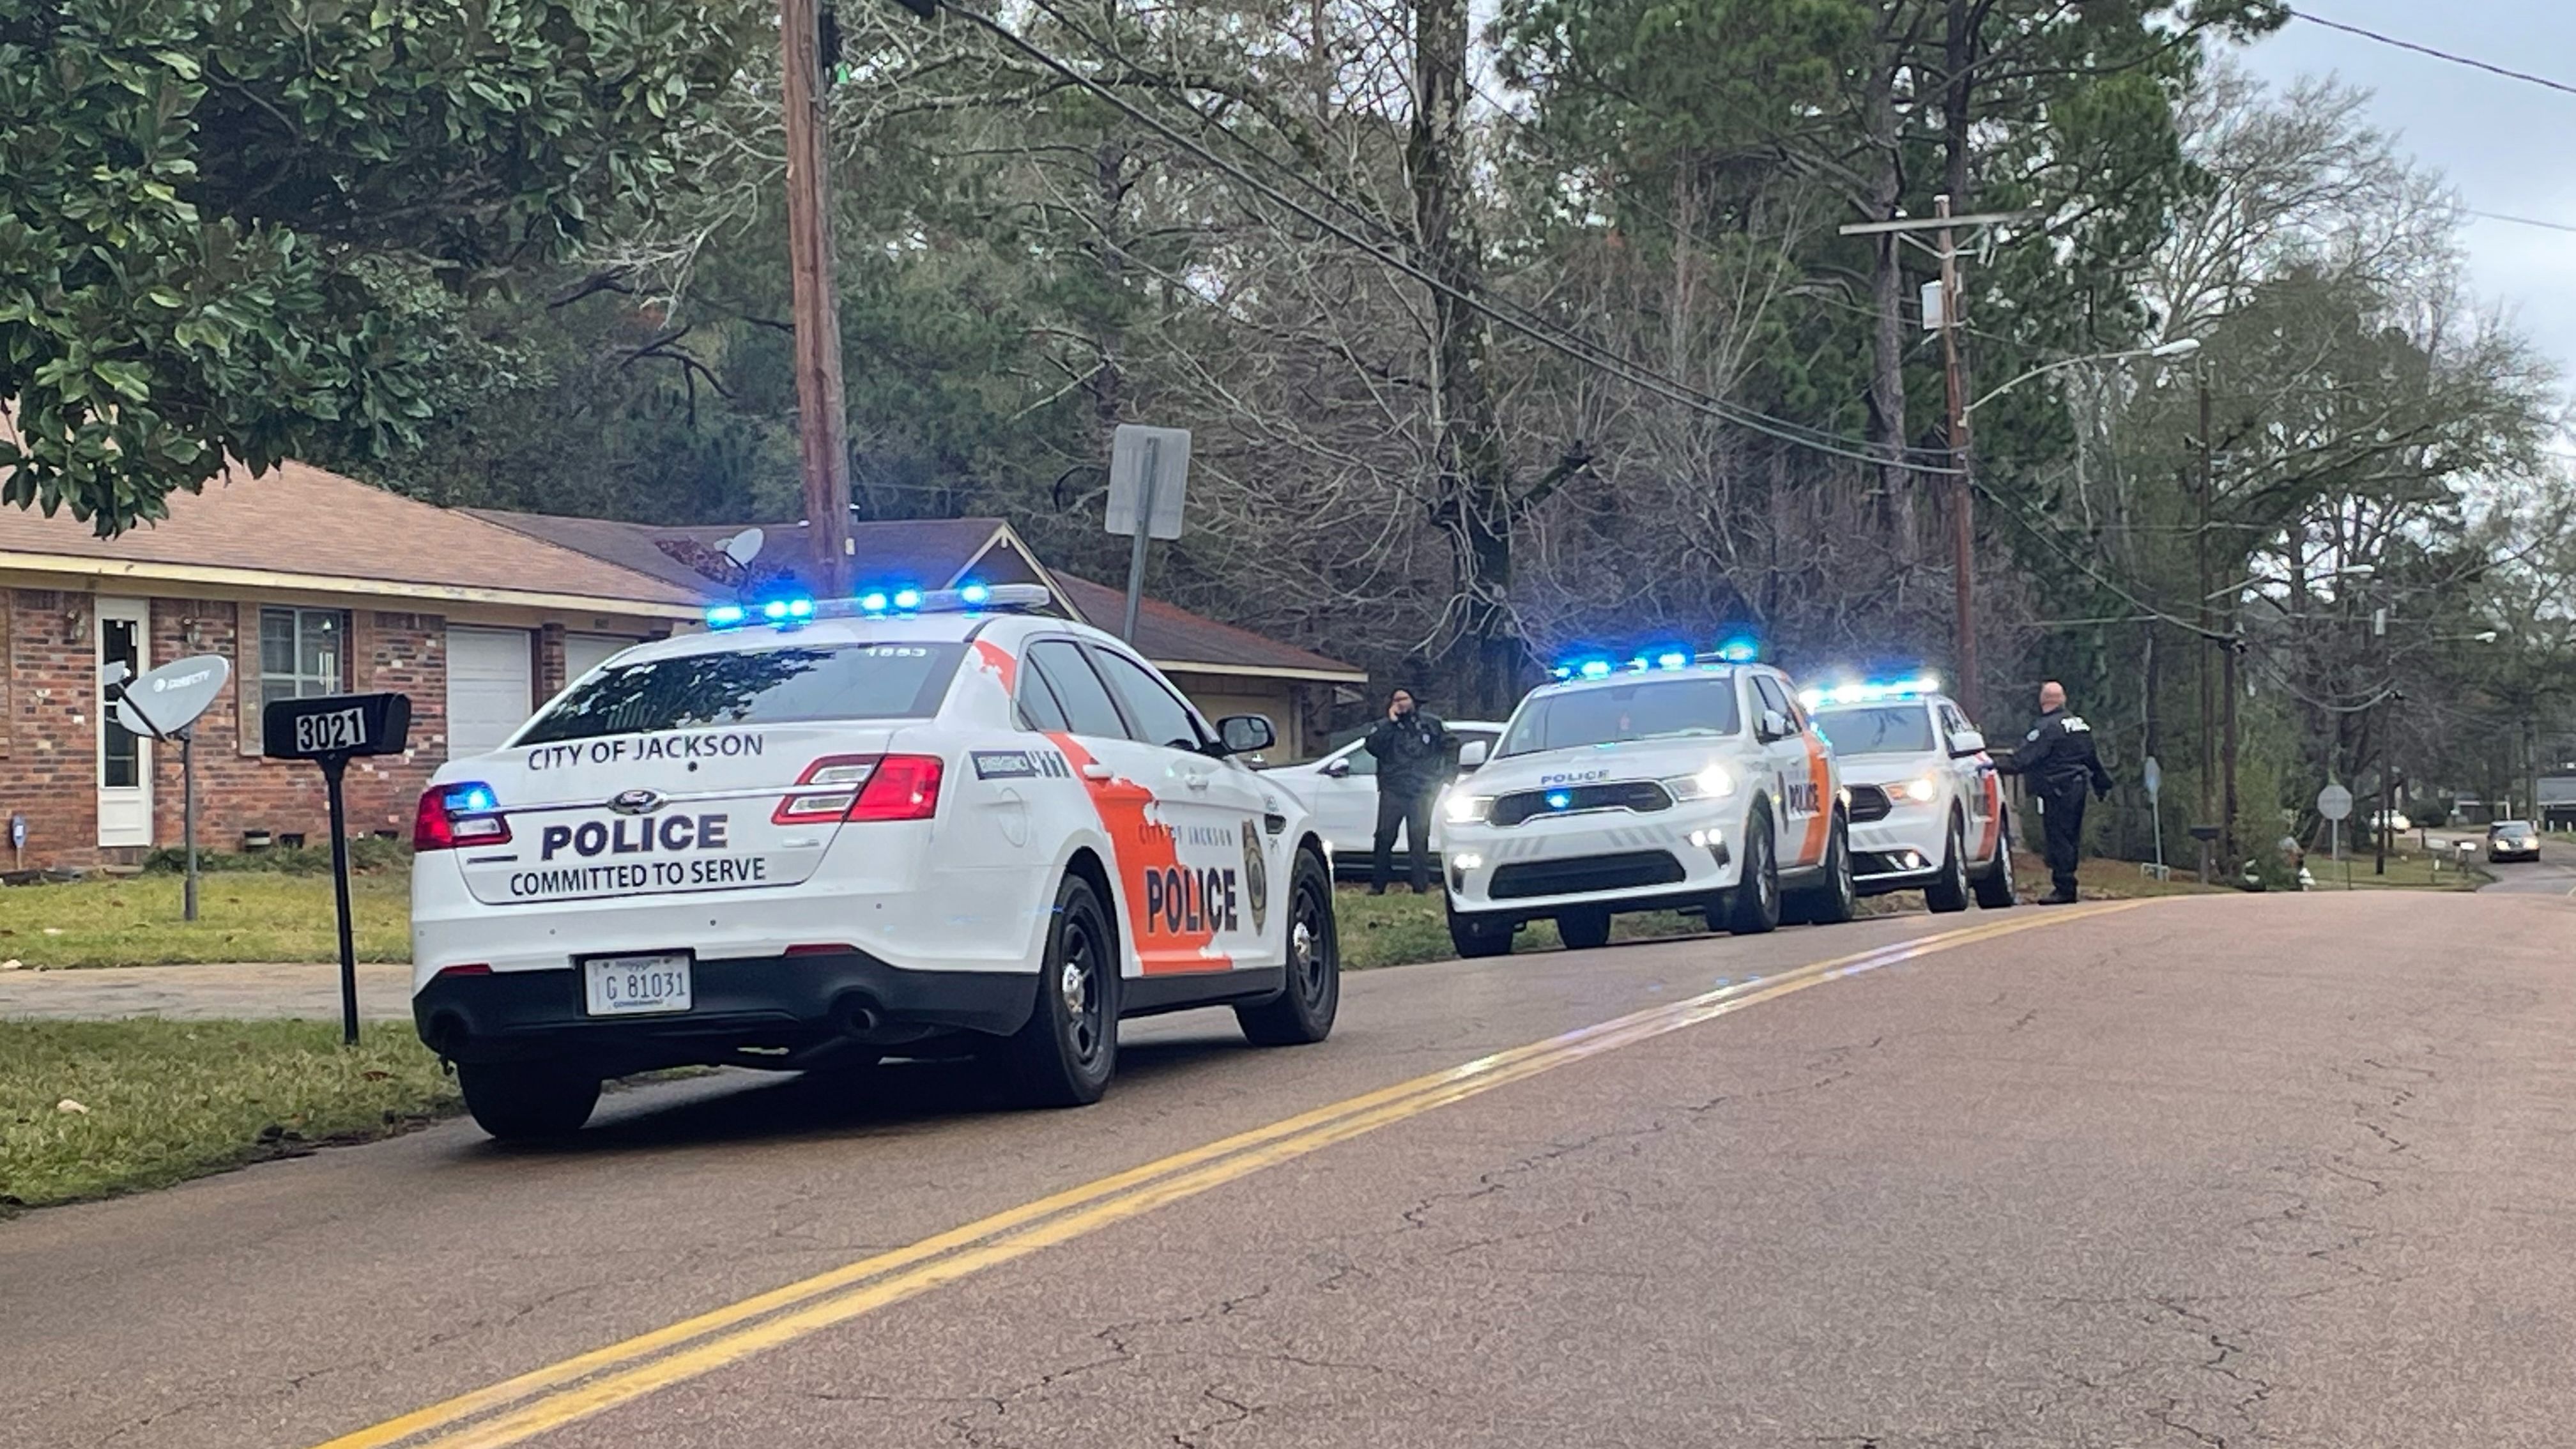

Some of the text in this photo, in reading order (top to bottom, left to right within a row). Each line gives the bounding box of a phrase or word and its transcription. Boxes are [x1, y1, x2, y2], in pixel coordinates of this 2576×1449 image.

[300, 709, 361, 751] 3021
[528, 733, 763, 771] CITY OF JACKSON
[1540, 769, 1610, 785] POLICE
[540, 813, 729, 862] POLICE
[511, 857, 766, 896] COMMITTED TO SERVE
[1146, 866, 1238, 934] POLICE
[606, 972, 686, 1000] G 81031
